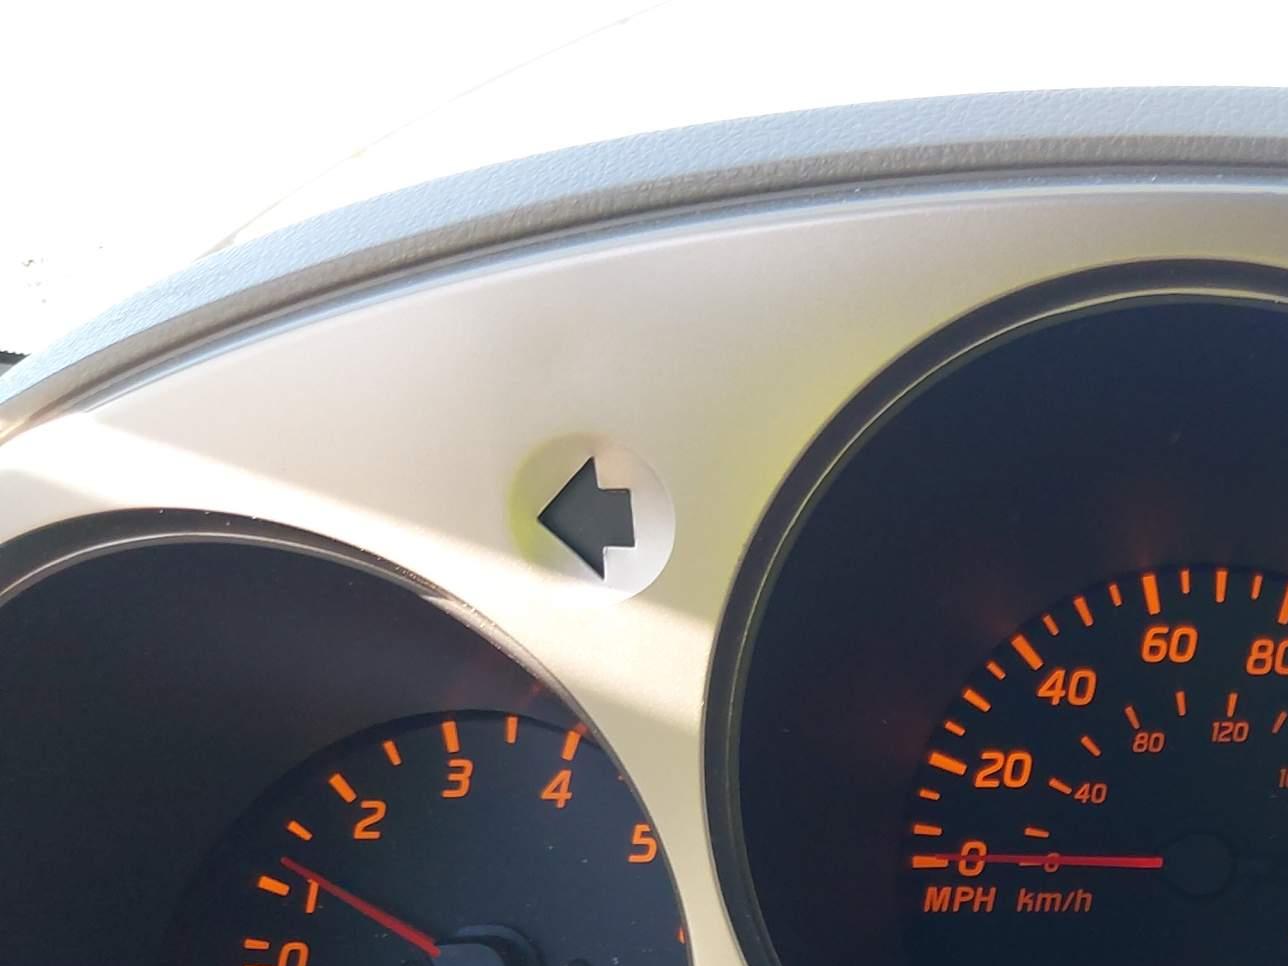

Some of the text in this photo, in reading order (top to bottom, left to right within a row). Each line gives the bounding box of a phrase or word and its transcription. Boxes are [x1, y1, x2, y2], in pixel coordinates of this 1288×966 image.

[1141, 625, 1198, 663] 60
[1037, 668, 1097, 706] 40
[1132, 732, 1165, 753] 80
[1211, 721, 1249, 743] 120
[442, 759, 473, 799] 3
[974, 751, 1033, 788] 20
[541, 770, 573, 808] 4
[1074, 783, 1108, 804] 40
[353, 801, 387, 840] 2
[628, 823, 657, 863] 5
[958, 840, 988, 877] 0
[1043, 852, 1062, 873] 0
[304, 879, 321, 913] 1
[923, 886, 1093, 913] MPH km/h
